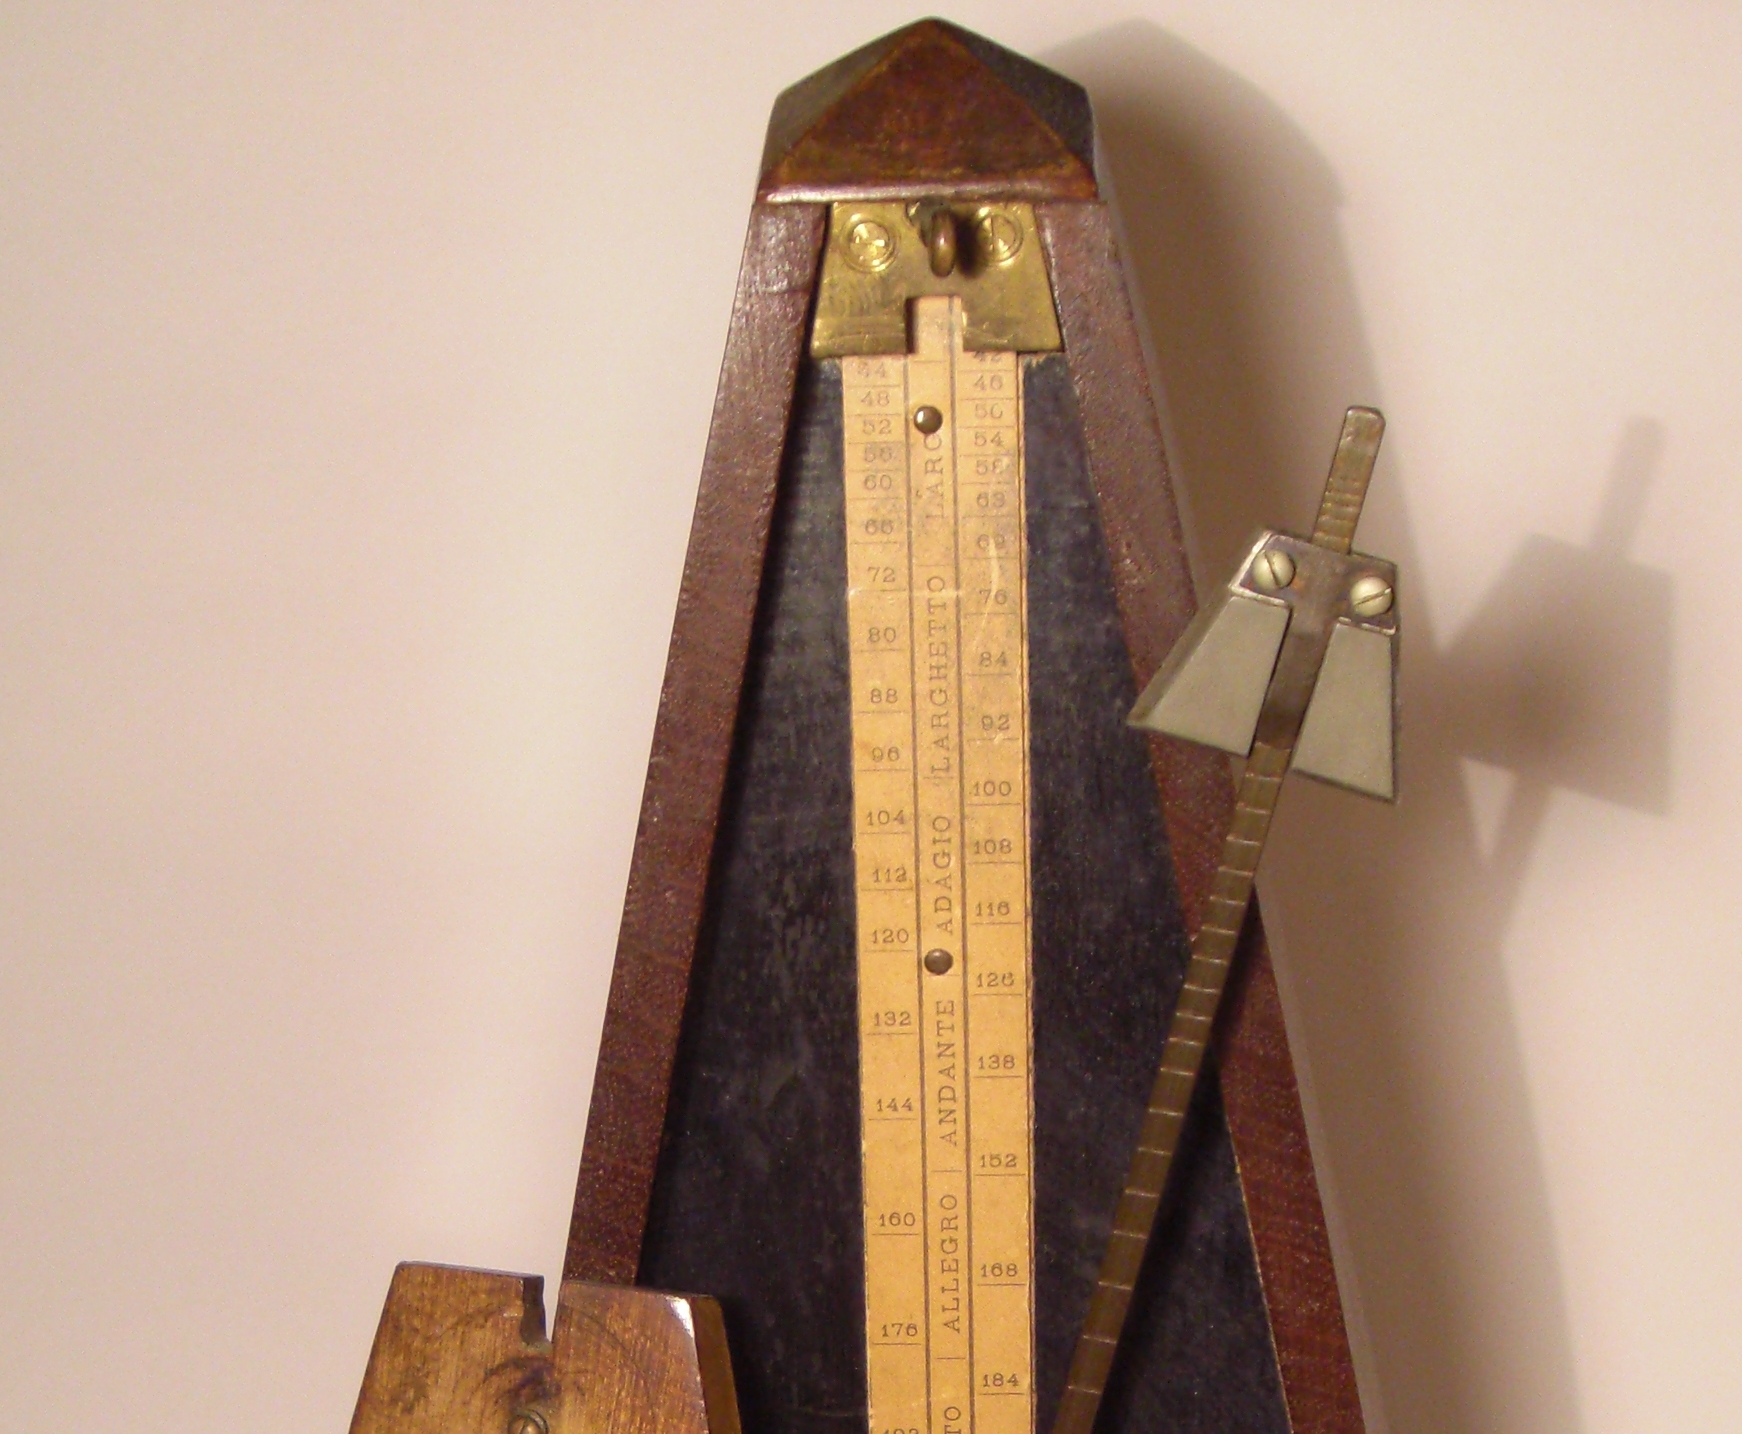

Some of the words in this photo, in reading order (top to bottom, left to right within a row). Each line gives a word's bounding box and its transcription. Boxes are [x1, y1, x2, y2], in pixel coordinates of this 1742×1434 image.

[973, 375, 1004, 392] 46
[860, 390, 891, 407] 48
[862, 419, 892, 435] 52
[973, 431, 1006, 448] 54
[863, 474, 892, 491] 60
[864, 519, 894, 536] 66
[867, 566, 896, 583] 72
[978, 589, 1008, 606] 76
[867, 627, 897, 643] 80
[979, 651, 1008, 668] 84
[926, 576, 949, 774] LARGHETTO
[870, 687, 899, 704] 88
[981, 714, 1010, 731] 92
[871, 746, 901, 762] 96
[972, 780, 1012, 797] 100
[867, 809, 906, 826] 104
[973, 838, 1013, 856] 108
[872, 866, 908, 883] 112
[932, 816, 953, 935] ADAGIO
[975, 901, 1010, 917] 116
[871, 928, 910, 944] 120
[976, 972, 1015, 988] 126
[873, 1011, 912, 1027] 132
[977, 1055, 1016, 1070] 138
[936, 1000, 957, 1147] ANDANTE
[876, 1097, 914, 1113] 144
[979, 1153, 1018, 1169] 152
[878, 1211, 917, 1228] 160
[940, 1194, 961, 1335] ALLEGRO
[980, 1262, 1018, 1278] 168
[881, 1321, 918, 1338] 176
[982, 1372, 1020, 1388] 184
